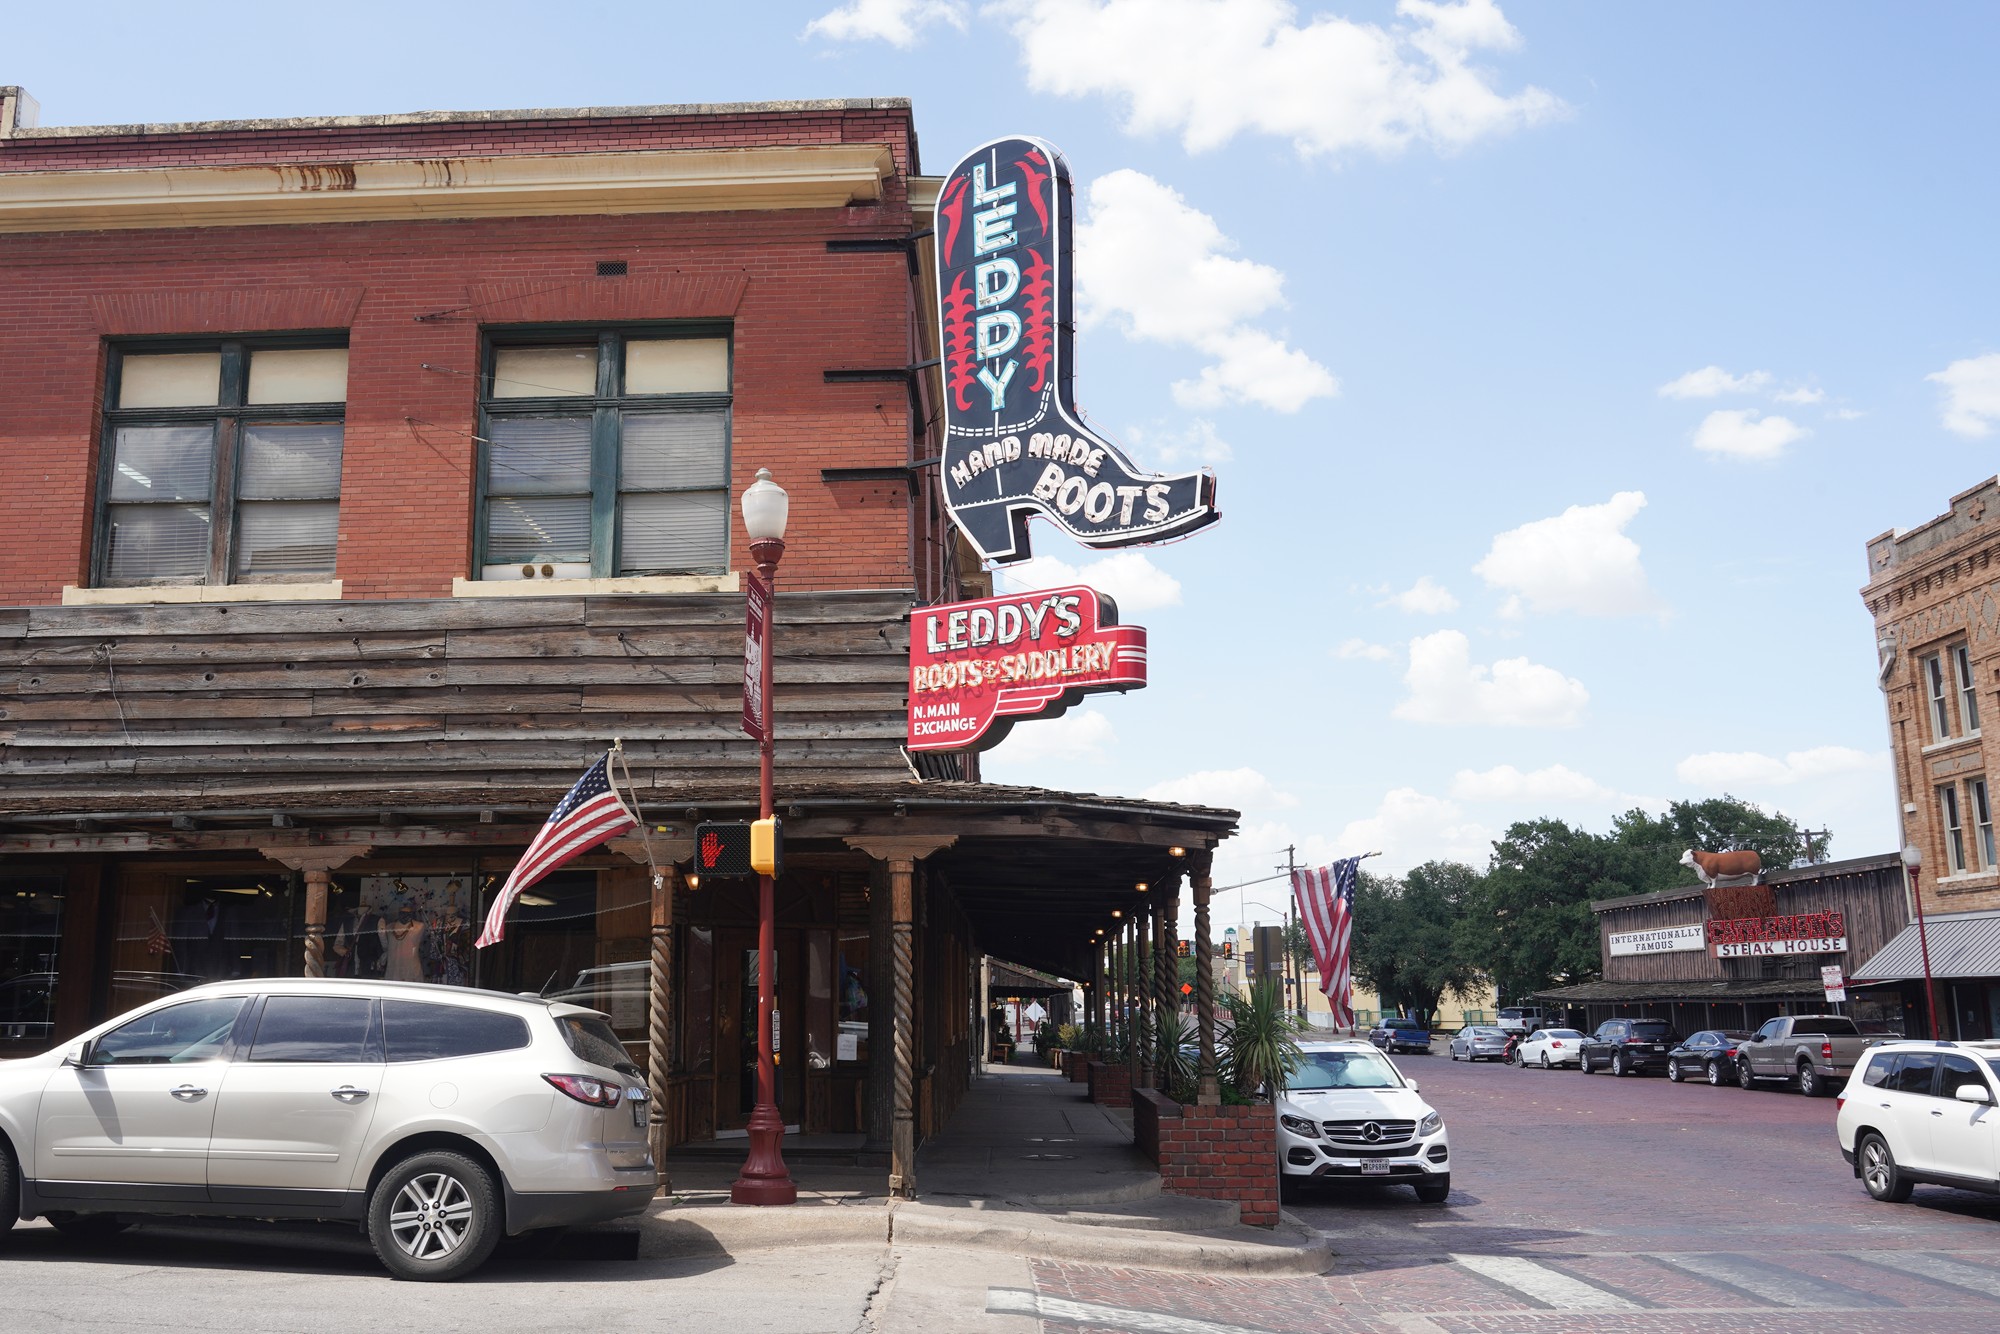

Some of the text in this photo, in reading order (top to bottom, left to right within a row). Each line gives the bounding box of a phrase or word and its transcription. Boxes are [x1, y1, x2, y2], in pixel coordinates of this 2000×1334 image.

[973, 163, 1021, 410] LEDDY
[951, 432, 1107, 489] HAND MADE
[1032, 461, 1171, 525] BOOTS
[926, 594, 1081, 654] LEDDY'S
[914, 658, 983, 693] BOOTS
[999, 641, 1116, 682] SADDLERY
[913, 717, 977, 736] EXCHANGE
[1611, 928, 1702, 945] INTERNATIONALLY
[1635, 940, 1674, 952] FAMOUS
[1722, 938, 1841, 956] STEAK HOUSE
